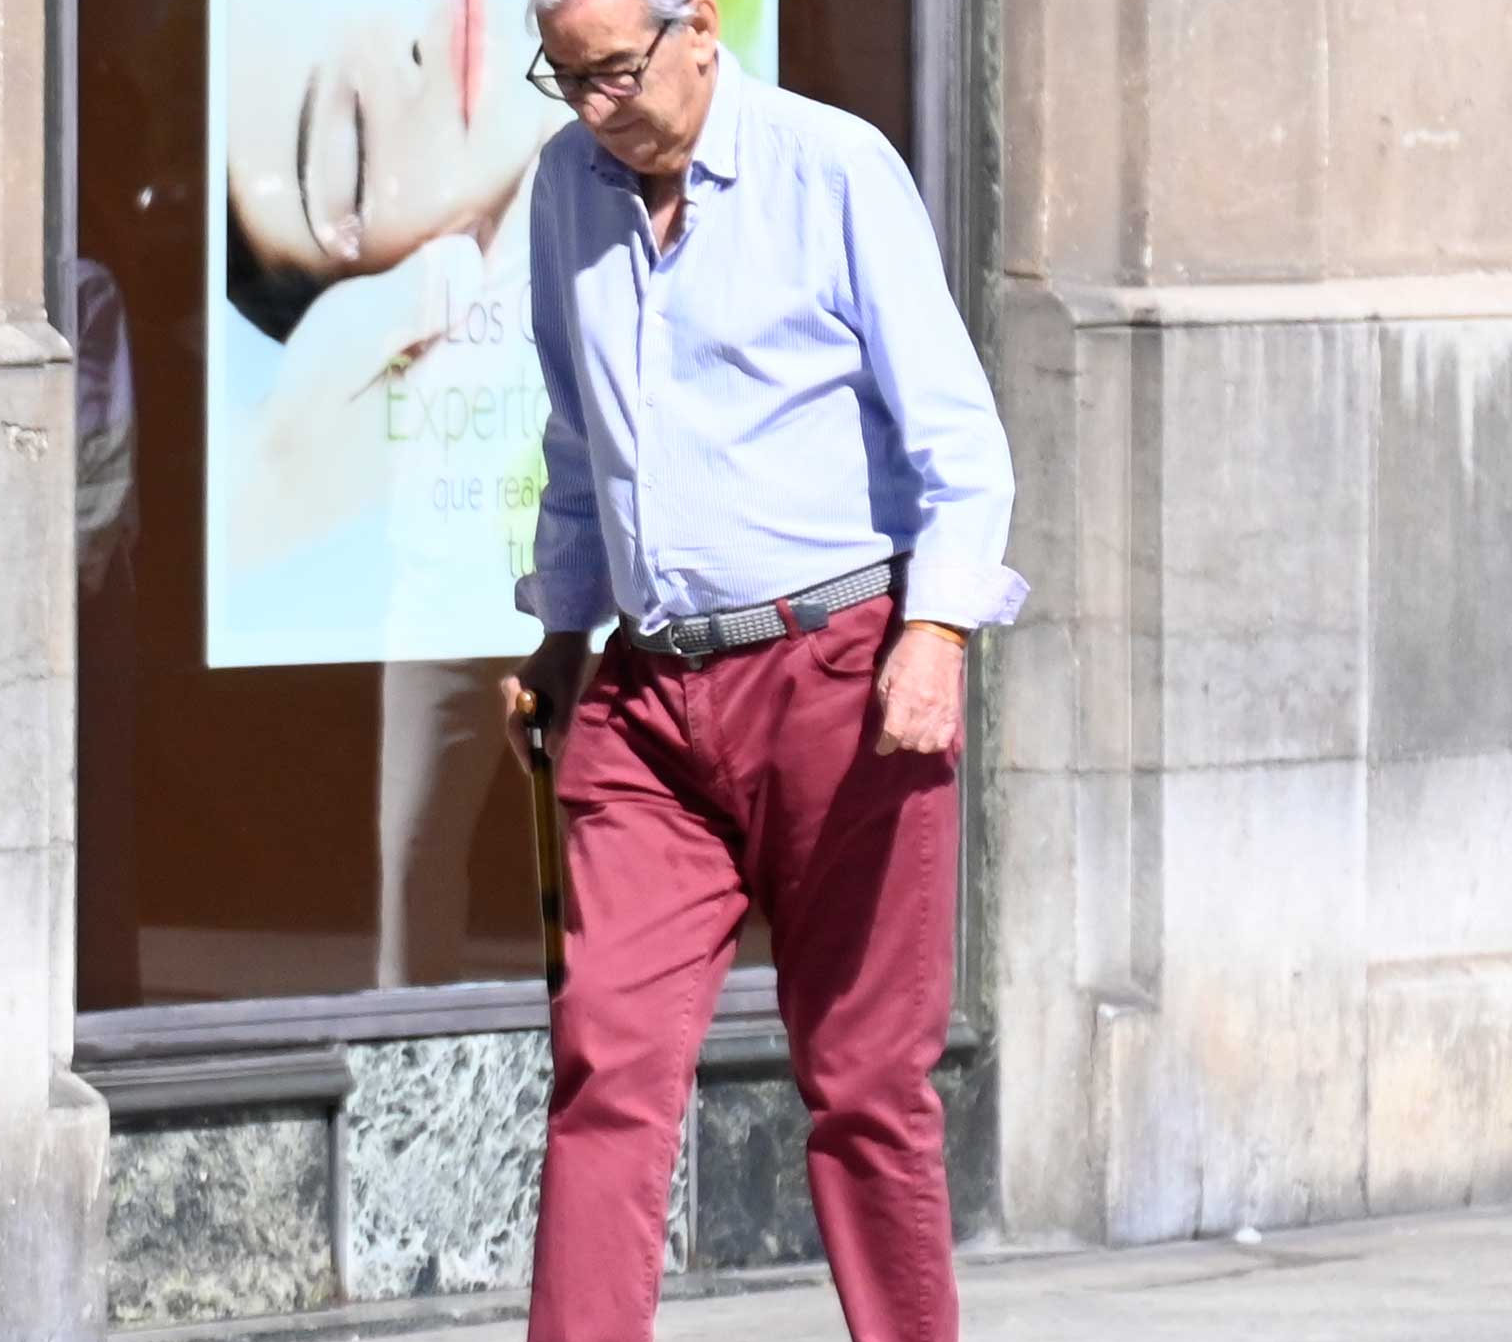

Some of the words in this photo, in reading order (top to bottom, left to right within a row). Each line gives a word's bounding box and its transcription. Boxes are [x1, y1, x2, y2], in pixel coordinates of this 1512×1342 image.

[445, 277, 505, 345] Los
[433, 476, 483, 523] que
[506, 525, 536, 578] tu
